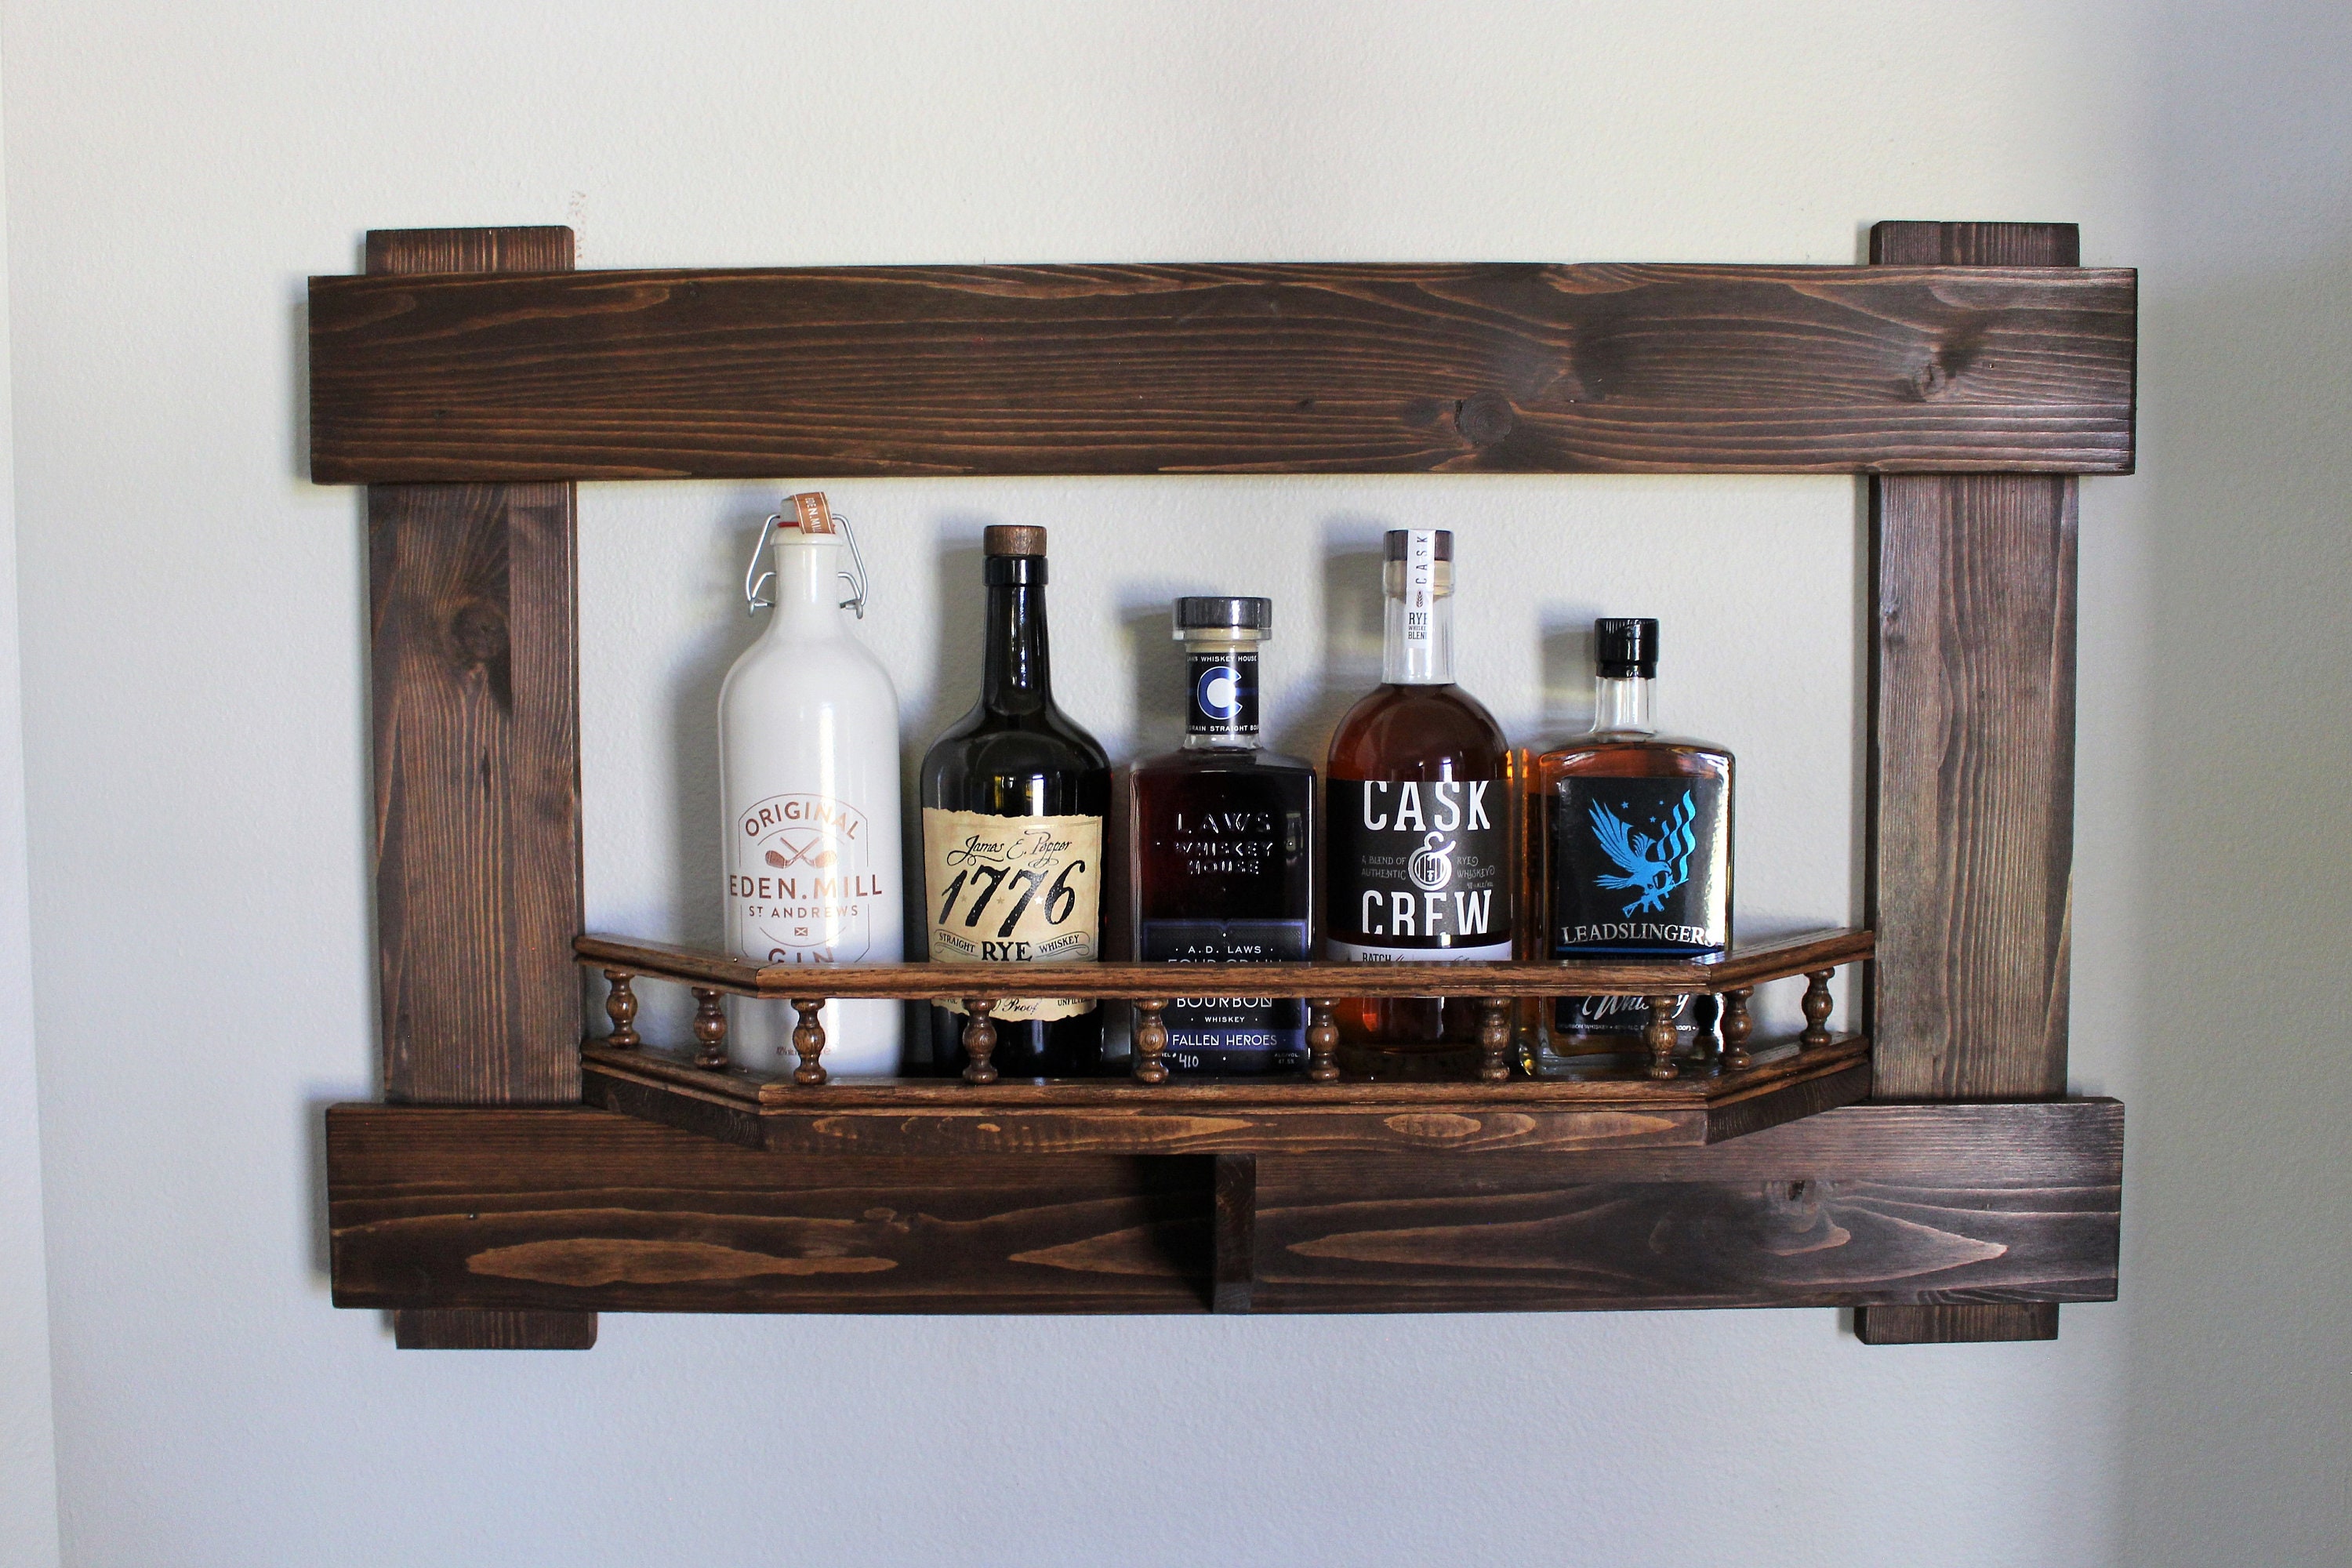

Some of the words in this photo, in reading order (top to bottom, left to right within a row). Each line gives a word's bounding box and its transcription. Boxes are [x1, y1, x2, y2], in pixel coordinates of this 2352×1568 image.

[1416, 536, 1428, 584] CASK
[1363, 780, 1490, 832] CASK
[746, 801, 858, 840] ORIGINAL
[1178, 812, 1271, 833] LAWS
[946, 834, 1004, 866] James
[1006, 839, 1026, 860] E.
[1024, 830, 1073, 869] Pepper
[1396, 857, 1406, 866] OF
[1408, 831, 1457, 891] &
[1457, 856, 1479, 866] RYE
[1361, 868, 1406, 880] AUTHENTIC
[1457, 865, 1495, 880] WHISKEY
[938, 859, 1086, 938] 1776
[771, 905, 858, 918] ANDREWS
[1362, 890, 1492, 937] CREW
[939, 932, 977, 953] STRAIGHT
[981, 940, 1033, 962] RYE
[1039, 934, 1080, 953] WHISKEY
[1227, 946, 1261, 954] LAWS
[1172, 1034, 1219, 1046] FALLEN
[1226, 1034, 1277, 1046] HEROES
[1178, 1053, 1199, 1069] 410
